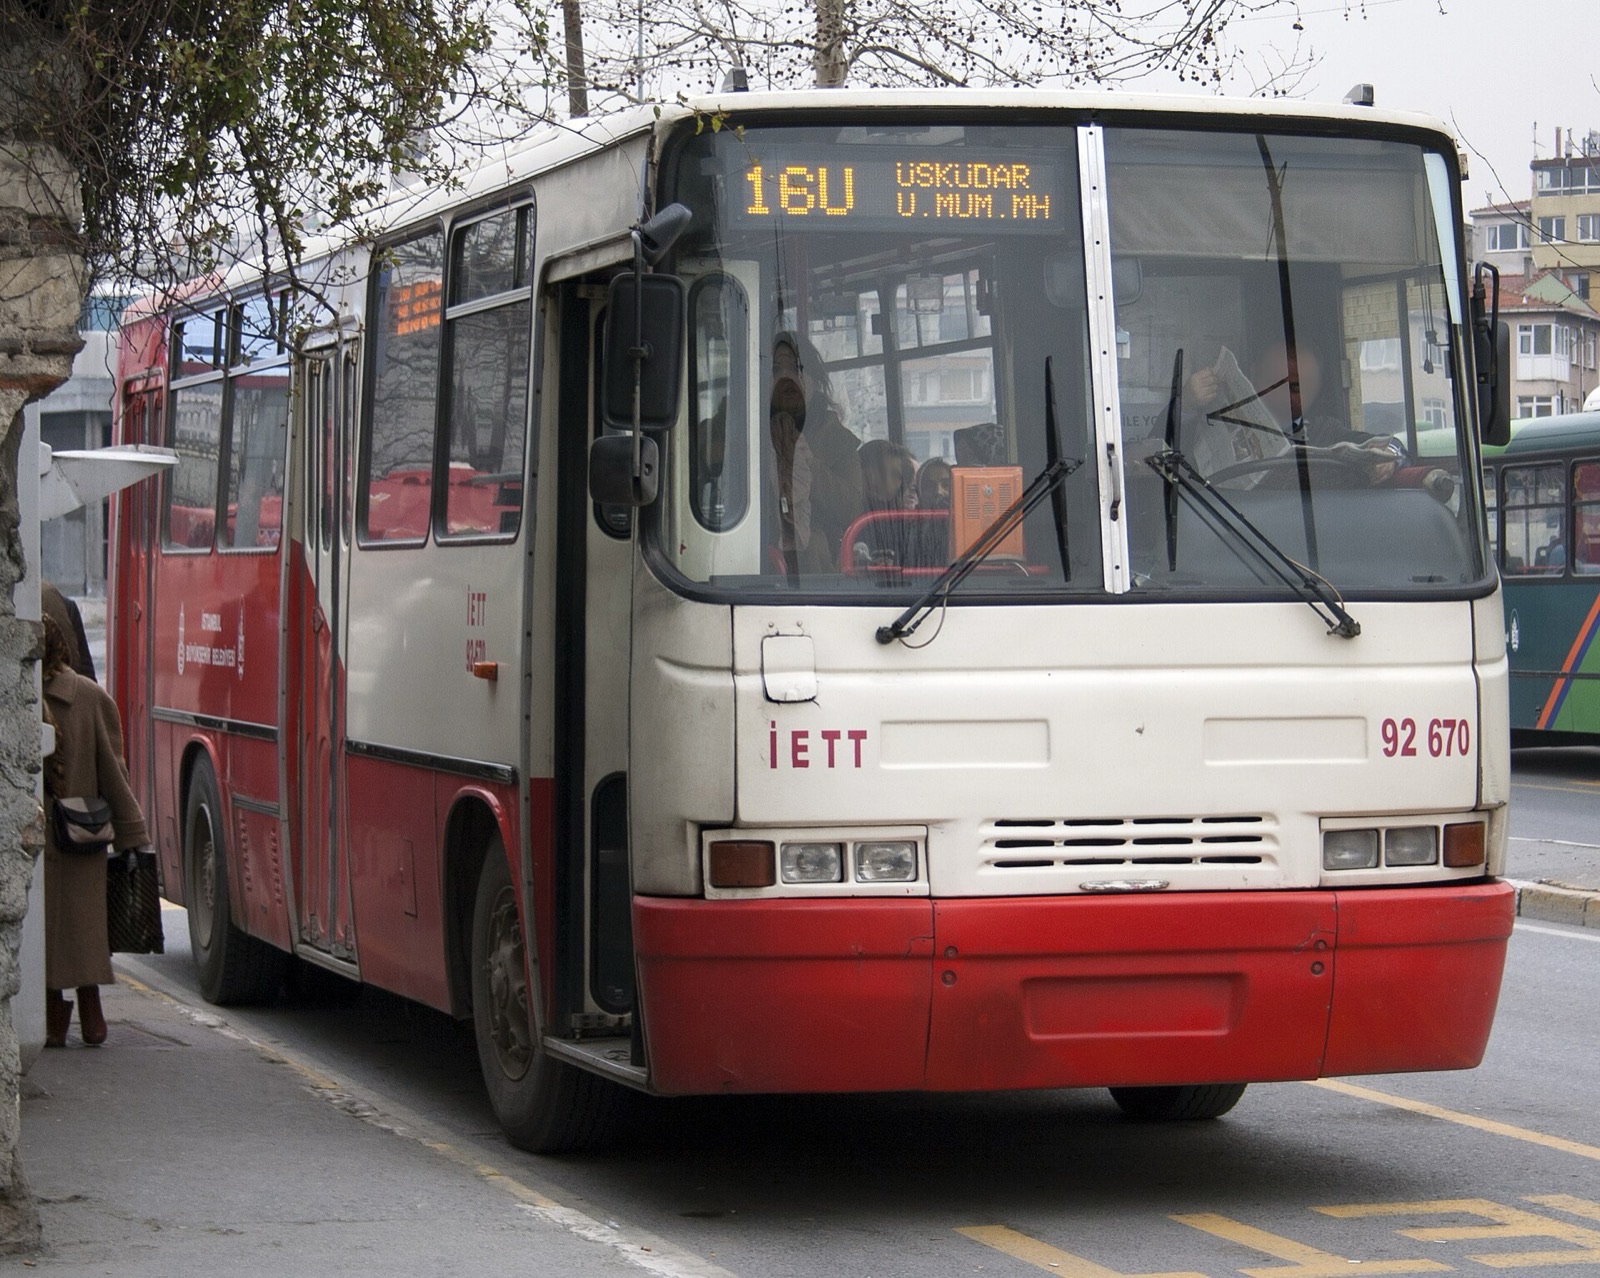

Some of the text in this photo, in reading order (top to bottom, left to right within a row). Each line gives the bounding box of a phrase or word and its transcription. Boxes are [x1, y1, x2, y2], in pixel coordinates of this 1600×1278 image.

[746, 166, 854, 215] 16U
[467, 583, 487, 627] İETT
[769, 720, 868, 769] İETT
[1381, 718, 1470, 758] 92 670
